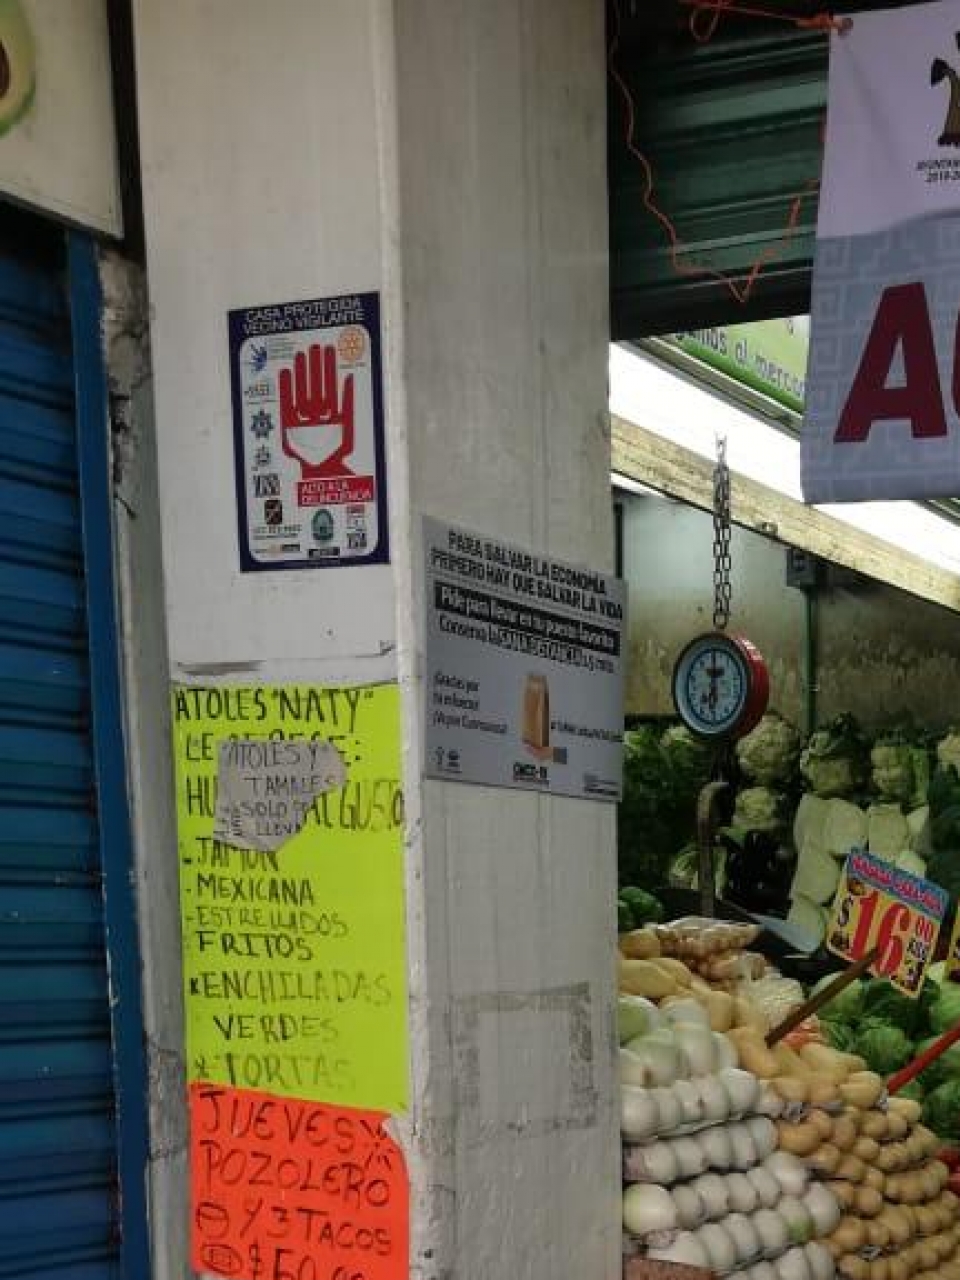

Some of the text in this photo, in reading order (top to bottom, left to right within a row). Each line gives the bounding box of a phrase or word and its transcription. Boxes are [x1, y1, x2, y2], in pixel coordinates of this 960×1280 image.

[448, 531, 482, 559] PARA
[484, 542, 533, 573] SALVAR
[534, 558, 549, 578] LA
[486, 563, 510, 586] HAY
[512, 572, 535, 595] QUE
[175, 688, 268, 722] ATOLES
[186, 733, 214, 761] LE
[197, 873, 316, 906] MEXICANA
[195, 906, 349, 939] ESTRELLADOS
[195, 931, 314, 961] FRITOS
[199, 969, 392, 1006] ENCHILADAS
[212, 1013, 339, 1044] VERDES
[216, 1052, 357, 1090] TORTAS
[199, 1090, 355, 1154] JUEVES
[199, 1139, 391, 1210] POZOLERO
[239, 1197, 392, 1256] Y 3 TACOS
